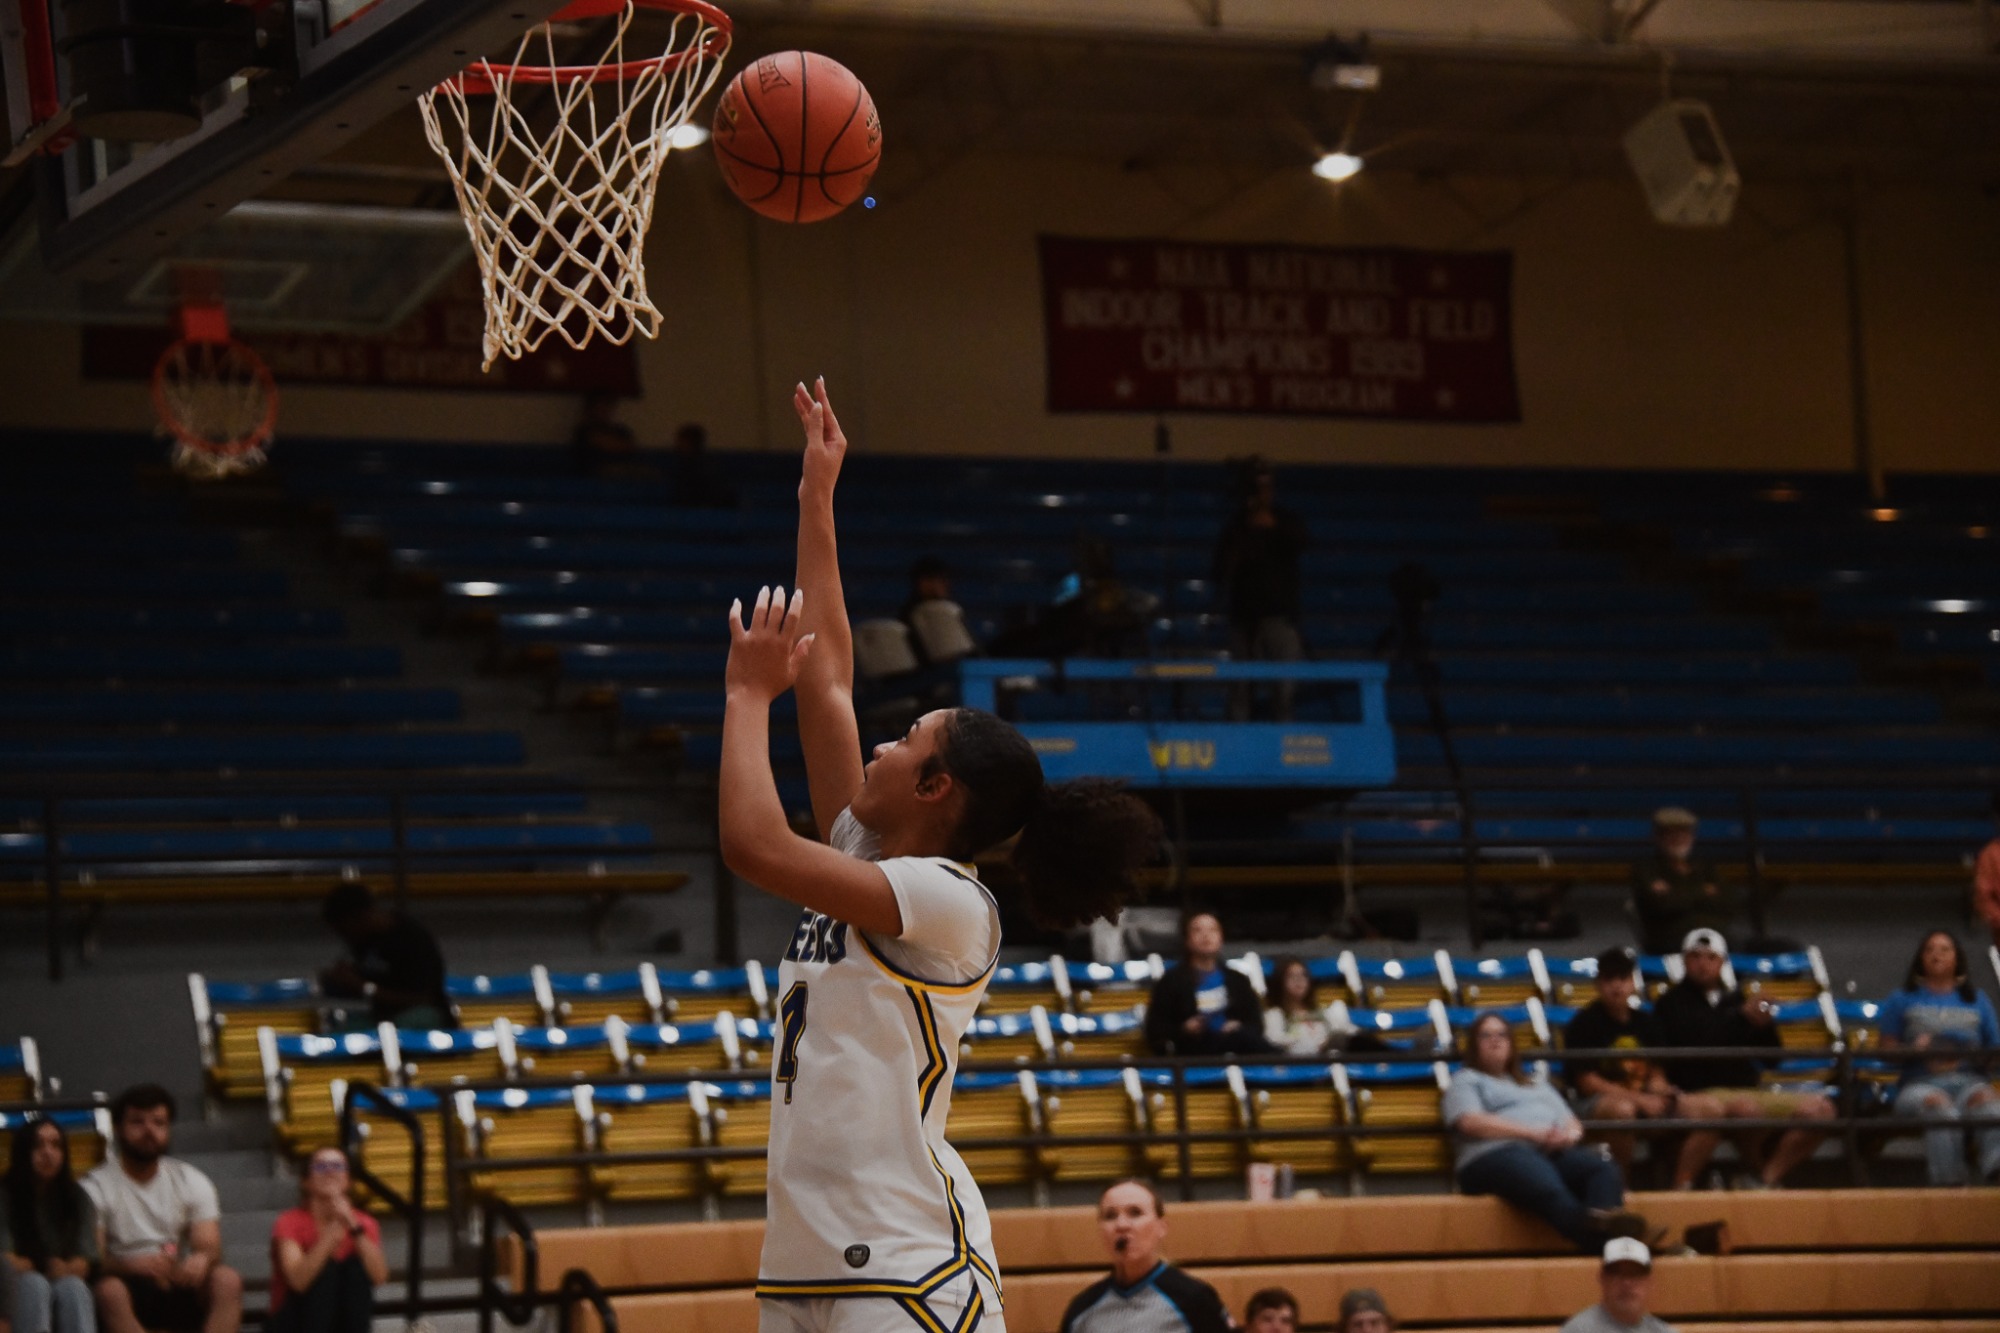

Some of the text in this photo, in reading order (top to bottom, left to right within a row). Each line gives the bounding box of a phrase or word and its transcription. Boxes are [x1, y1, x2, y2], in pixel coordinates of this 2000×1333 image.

[1248, 251, 1397, 294] NATIONAL
[1061, 288, 1496, 341] INDOOR TRACK AND FIELD
[1141, 330, 1331, 374] CHAMPIONS
[1176, 373, 1395, 412] MEN'S PROGRAM
[1147, 740, 1216, 770] WBU
